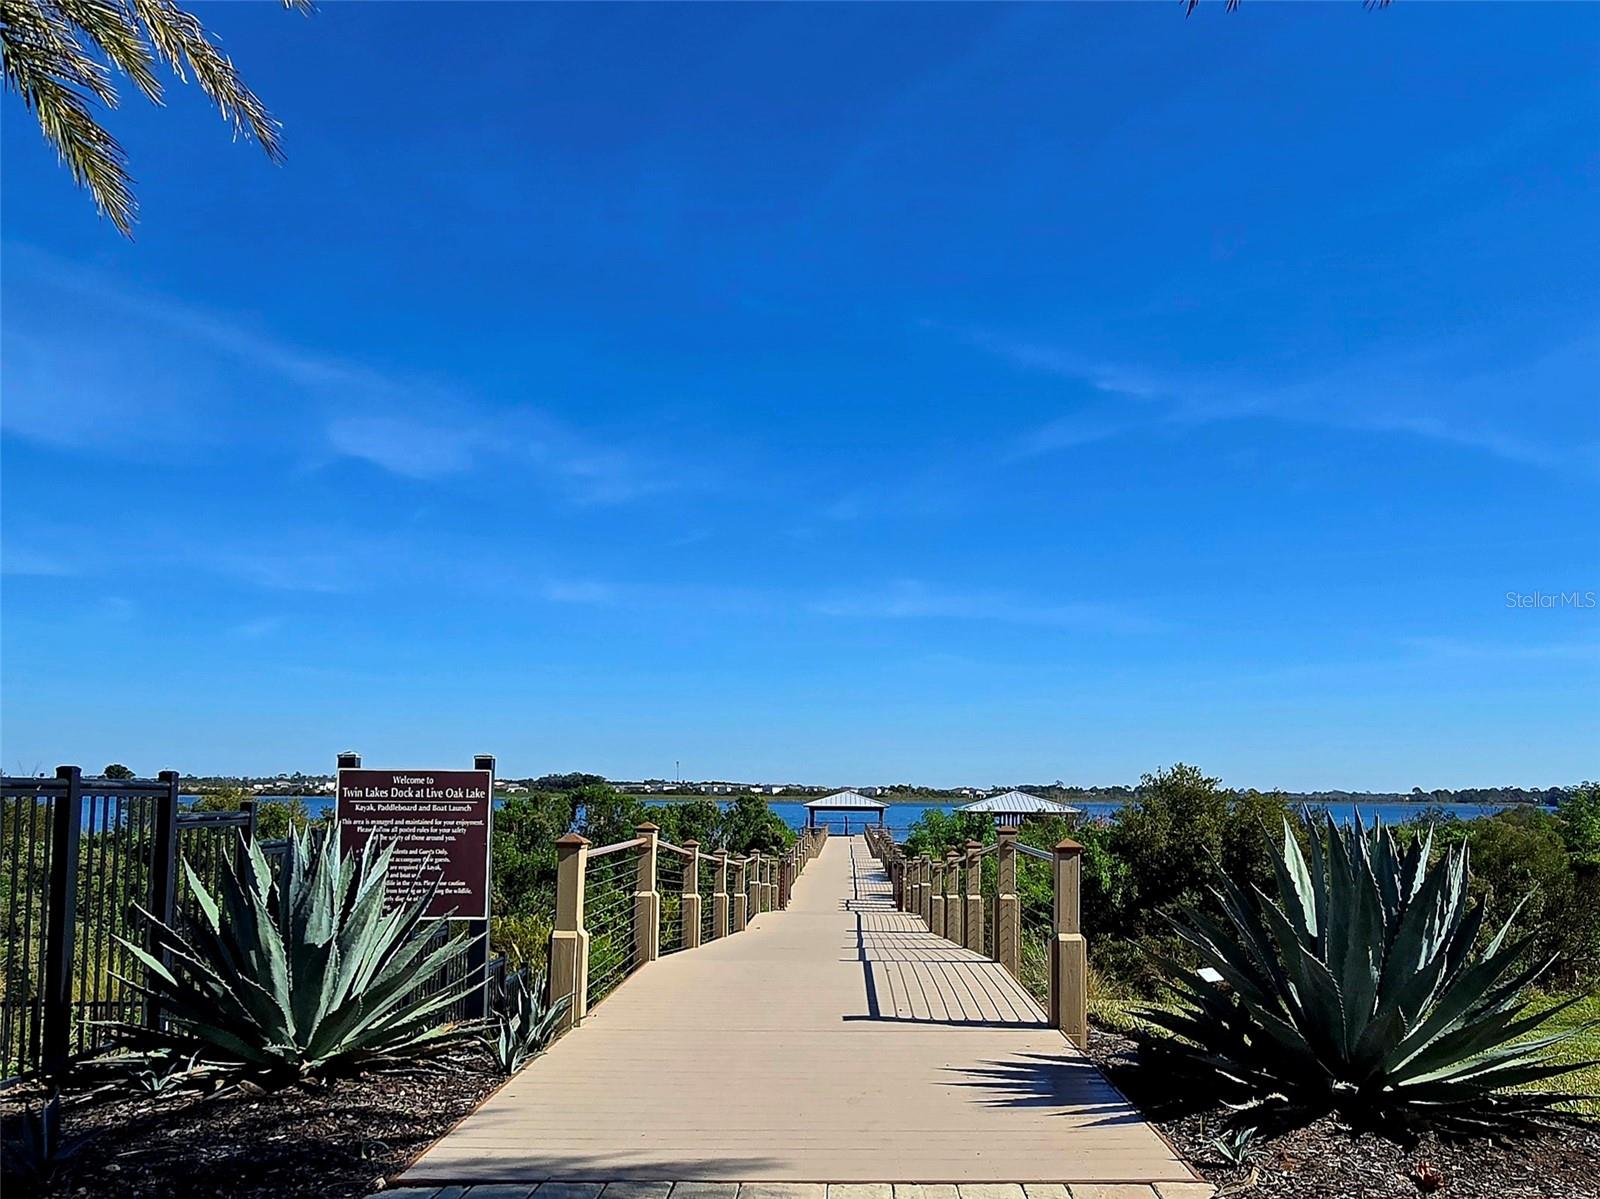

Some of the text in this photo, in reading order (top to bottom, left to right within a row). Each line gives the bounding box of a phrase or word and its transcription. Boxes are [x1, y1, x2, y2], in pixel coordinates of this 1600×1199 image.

[393, 775, 425, 784] Welcome
[342, 786, 486, 799] Twin Lakes Dock at Live Oak Lake
[355, 804, 376, 812] Kayak,
[448, 804, 472, 812] Launch
[456, 819, 484, 827] enjoyment.
[451, 826, 467, 835] safety
[445, 835, 457, 843] you.
